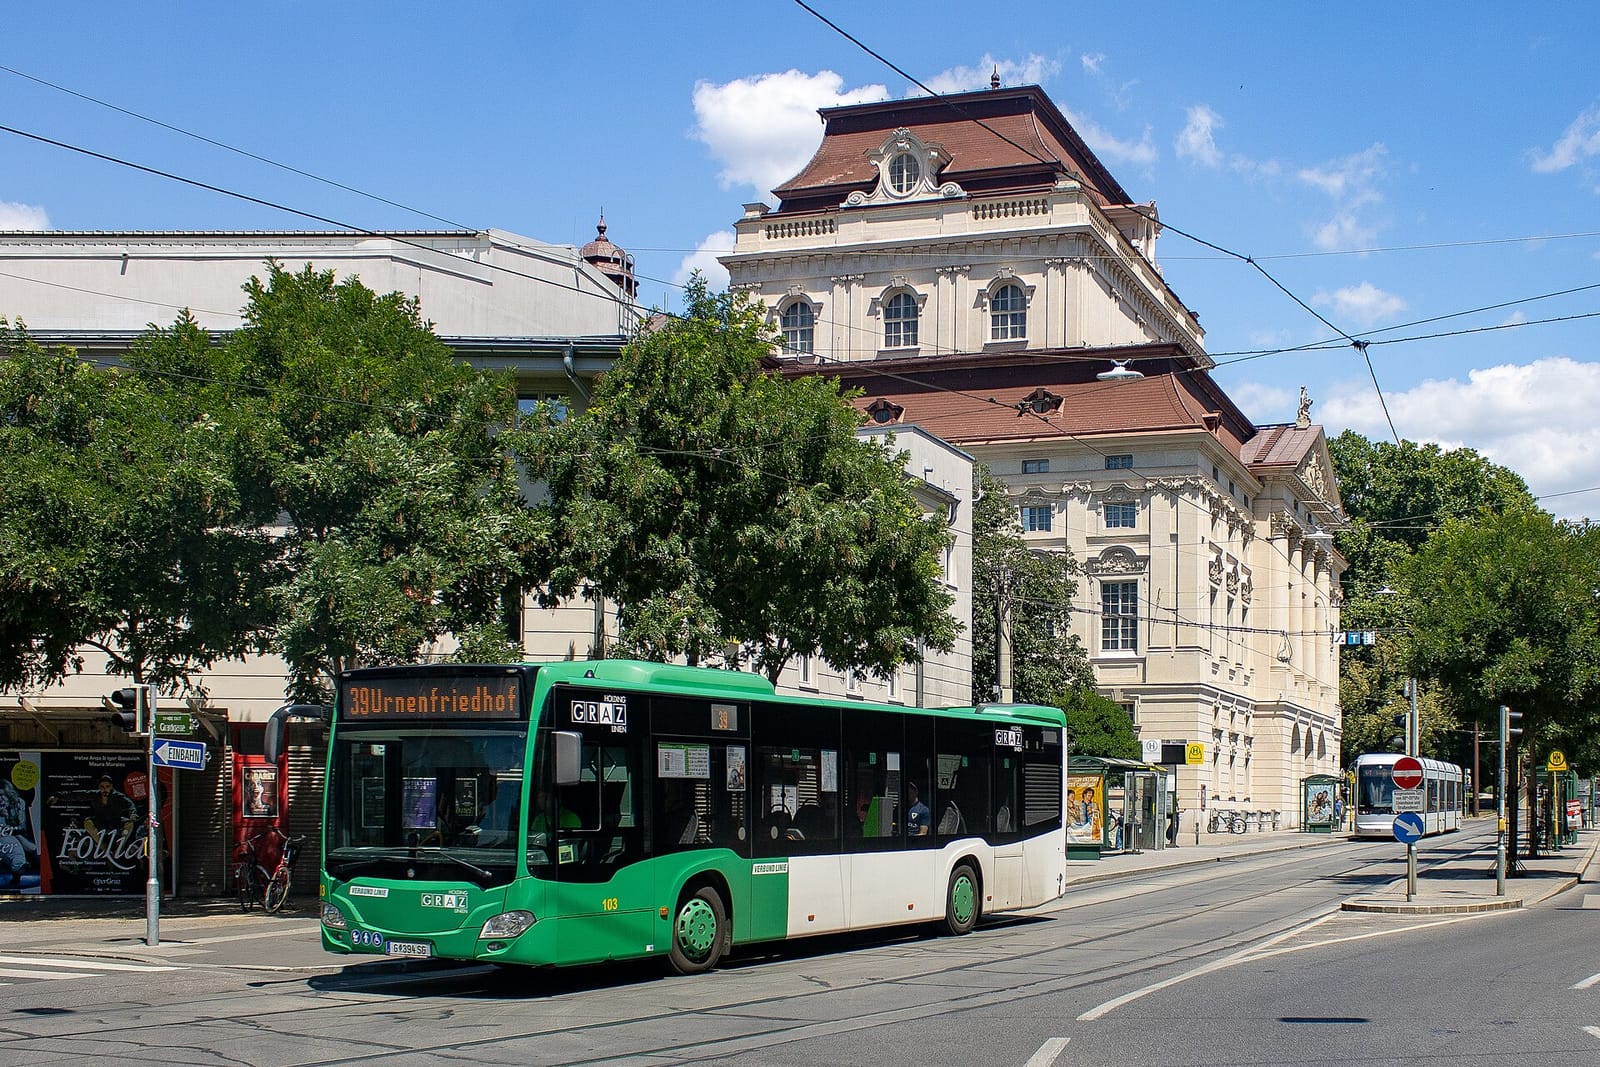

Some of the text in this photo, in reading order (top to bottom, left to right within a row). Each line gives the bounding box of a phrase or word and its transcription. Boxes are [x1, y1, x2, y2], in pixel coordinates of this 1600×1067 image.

[350, 685, 517, 715] 39 Urnenfriedhof
[573, 702, 625, 724] GRAZ
[995, 730, 1022, 746] GRAZ
[168, 747, 200, 762] EINBAHN
[56, 828, 148, 870] Follia
[422, 895, 467, 908] GRAZ
[602, 897, 618, 911] 103
